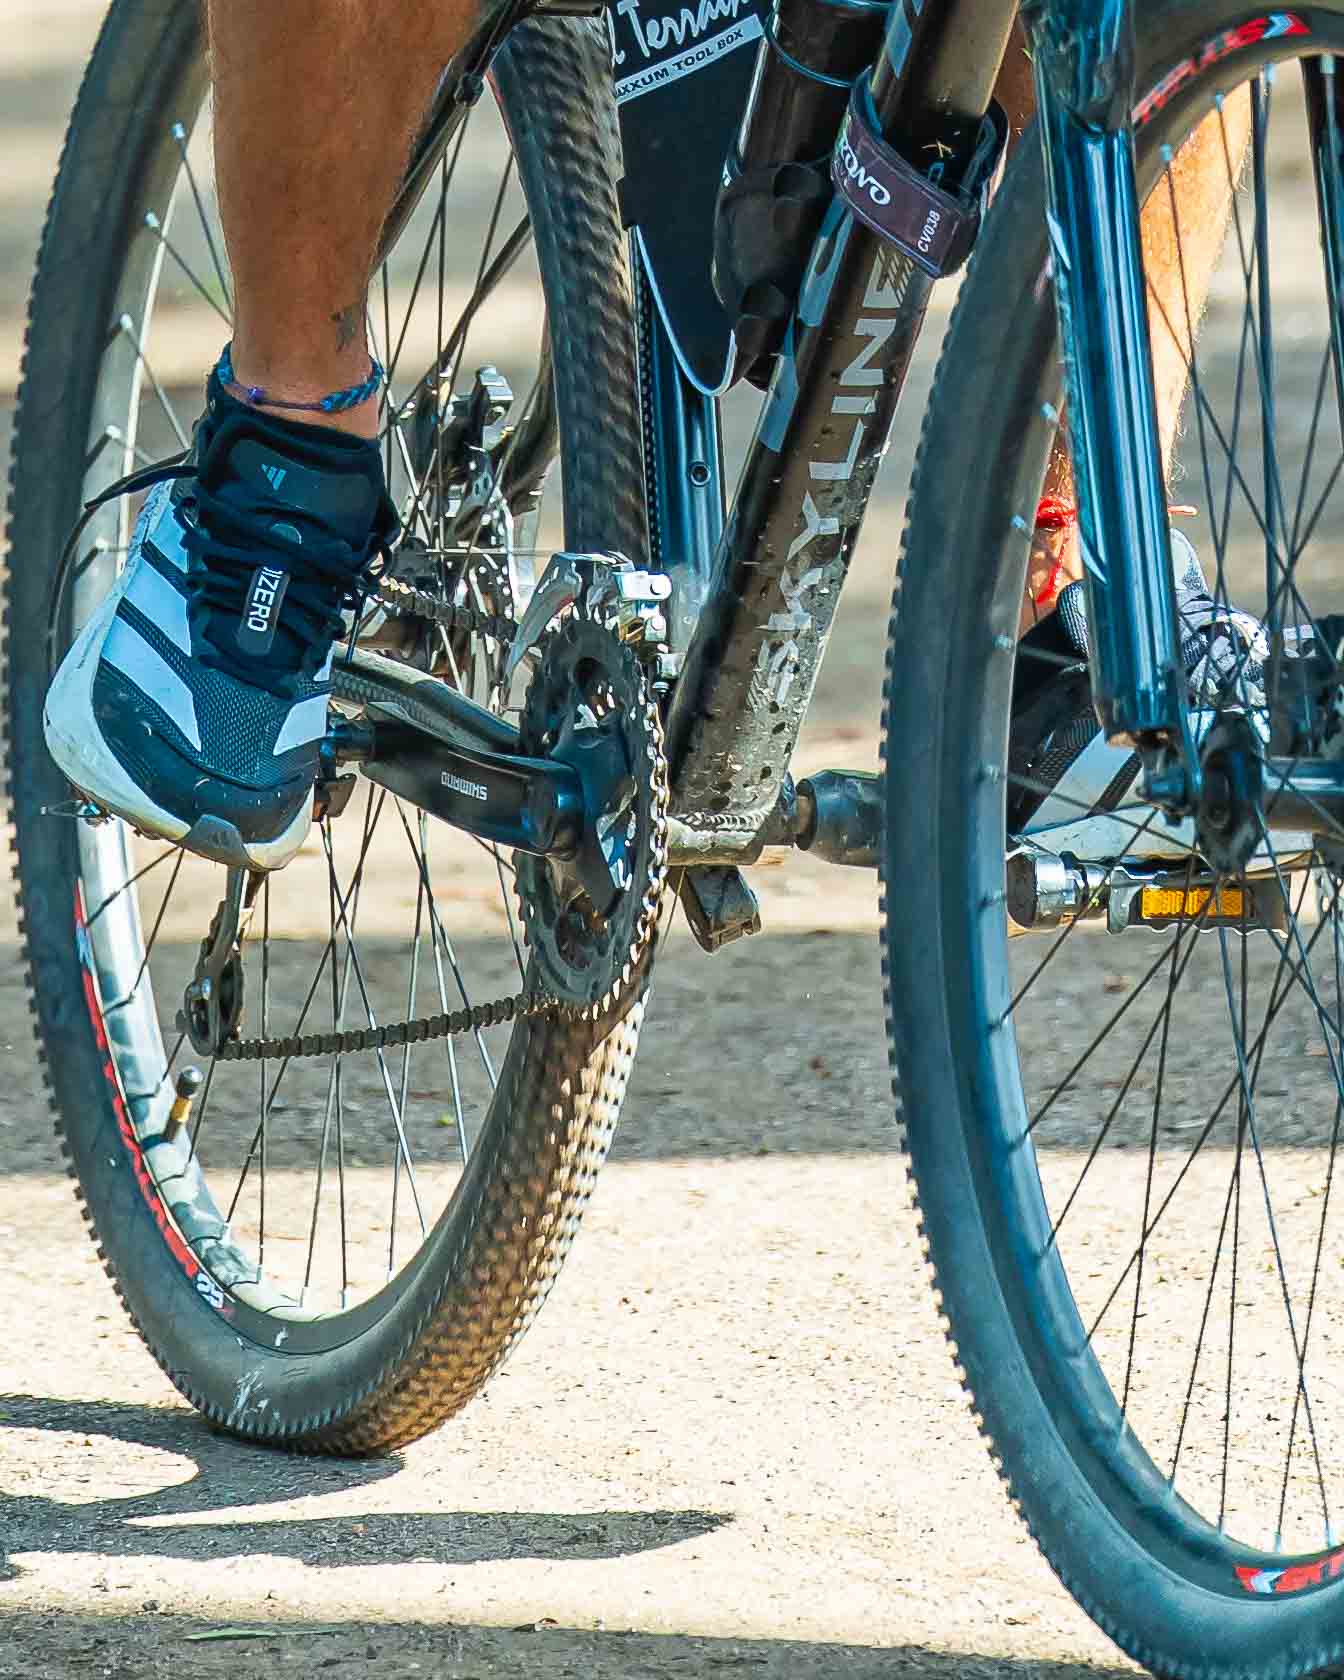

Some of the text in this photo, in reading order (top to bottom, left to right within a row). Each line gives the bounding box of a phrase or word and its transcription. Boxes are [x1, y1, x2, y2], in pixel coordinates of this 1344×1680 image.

[672, 48, 714, 71] TOOL
[717, 28, 744, 50] BOX
[917, 210, 941, 253] CV038
